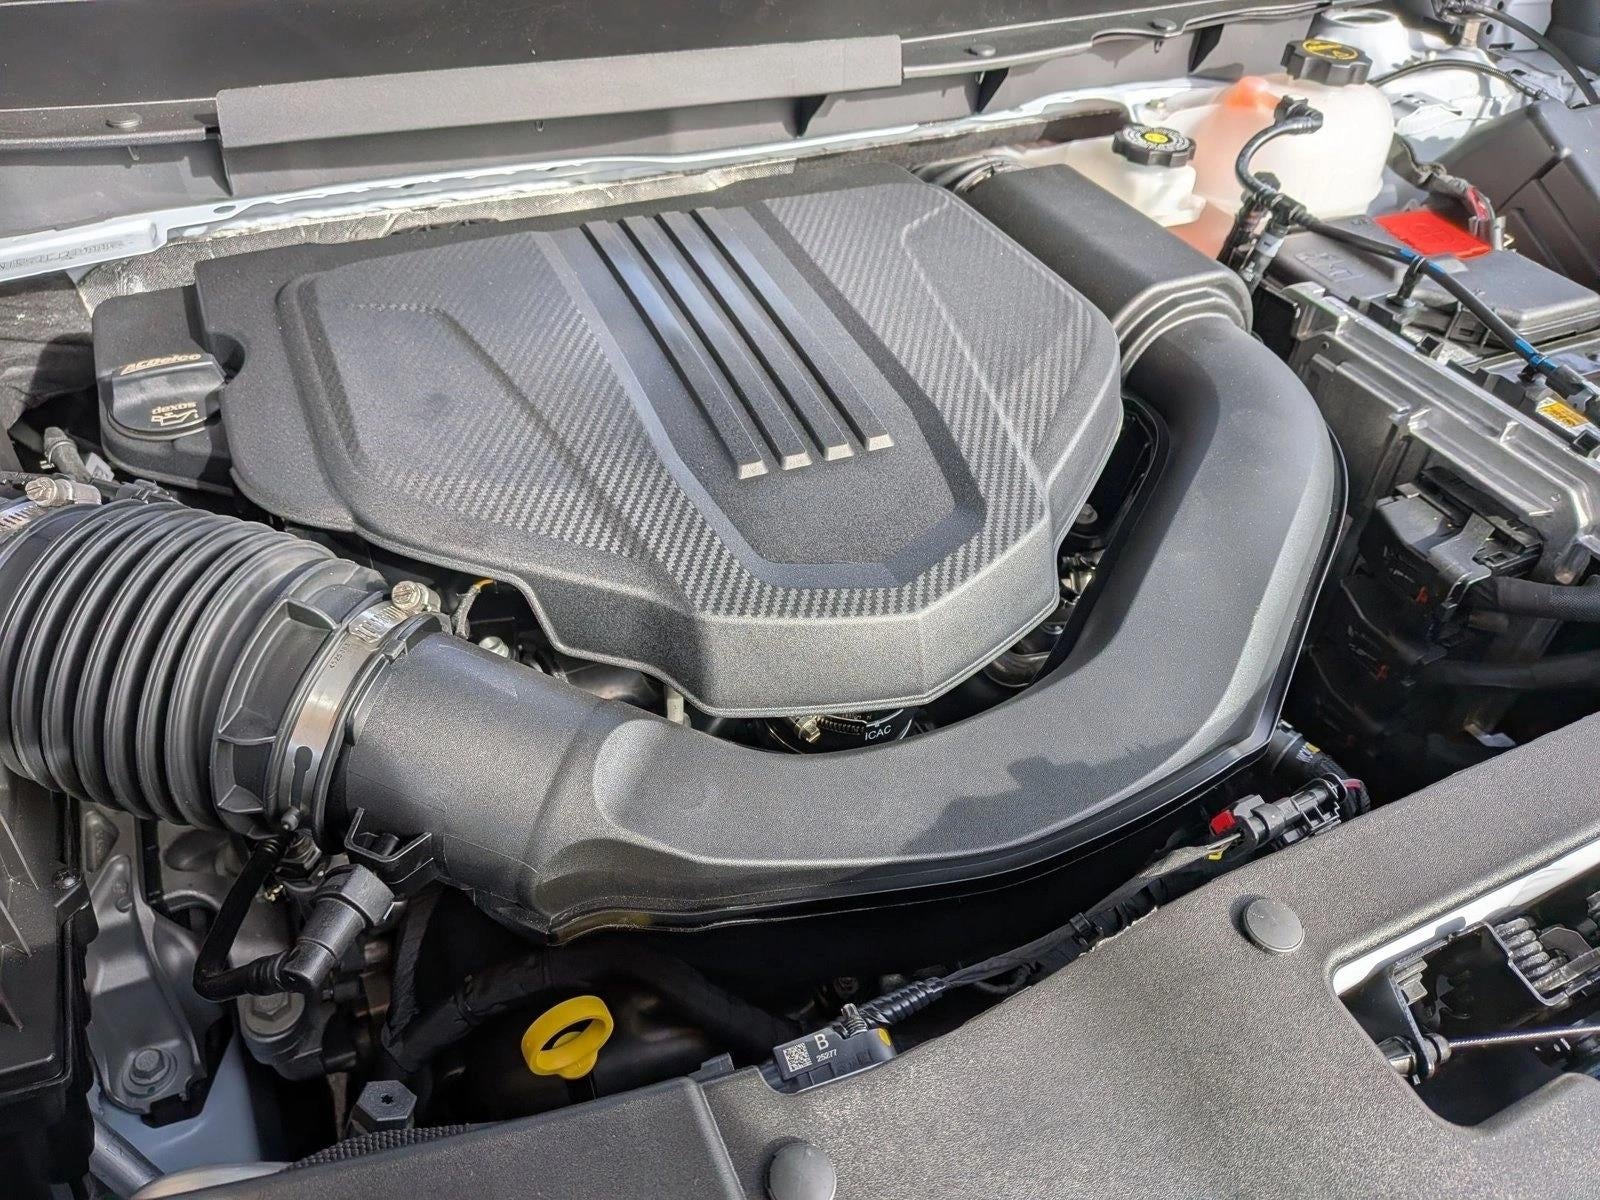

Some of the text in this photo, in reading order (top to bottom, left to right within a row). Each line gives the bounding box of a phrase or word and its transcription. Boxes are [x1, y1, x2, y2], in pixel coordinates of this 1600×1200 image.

[152, 402, 197, 414] dexos
[864, 725, 892, 740] ICAC
[814, 1033, 829, 1050] B
